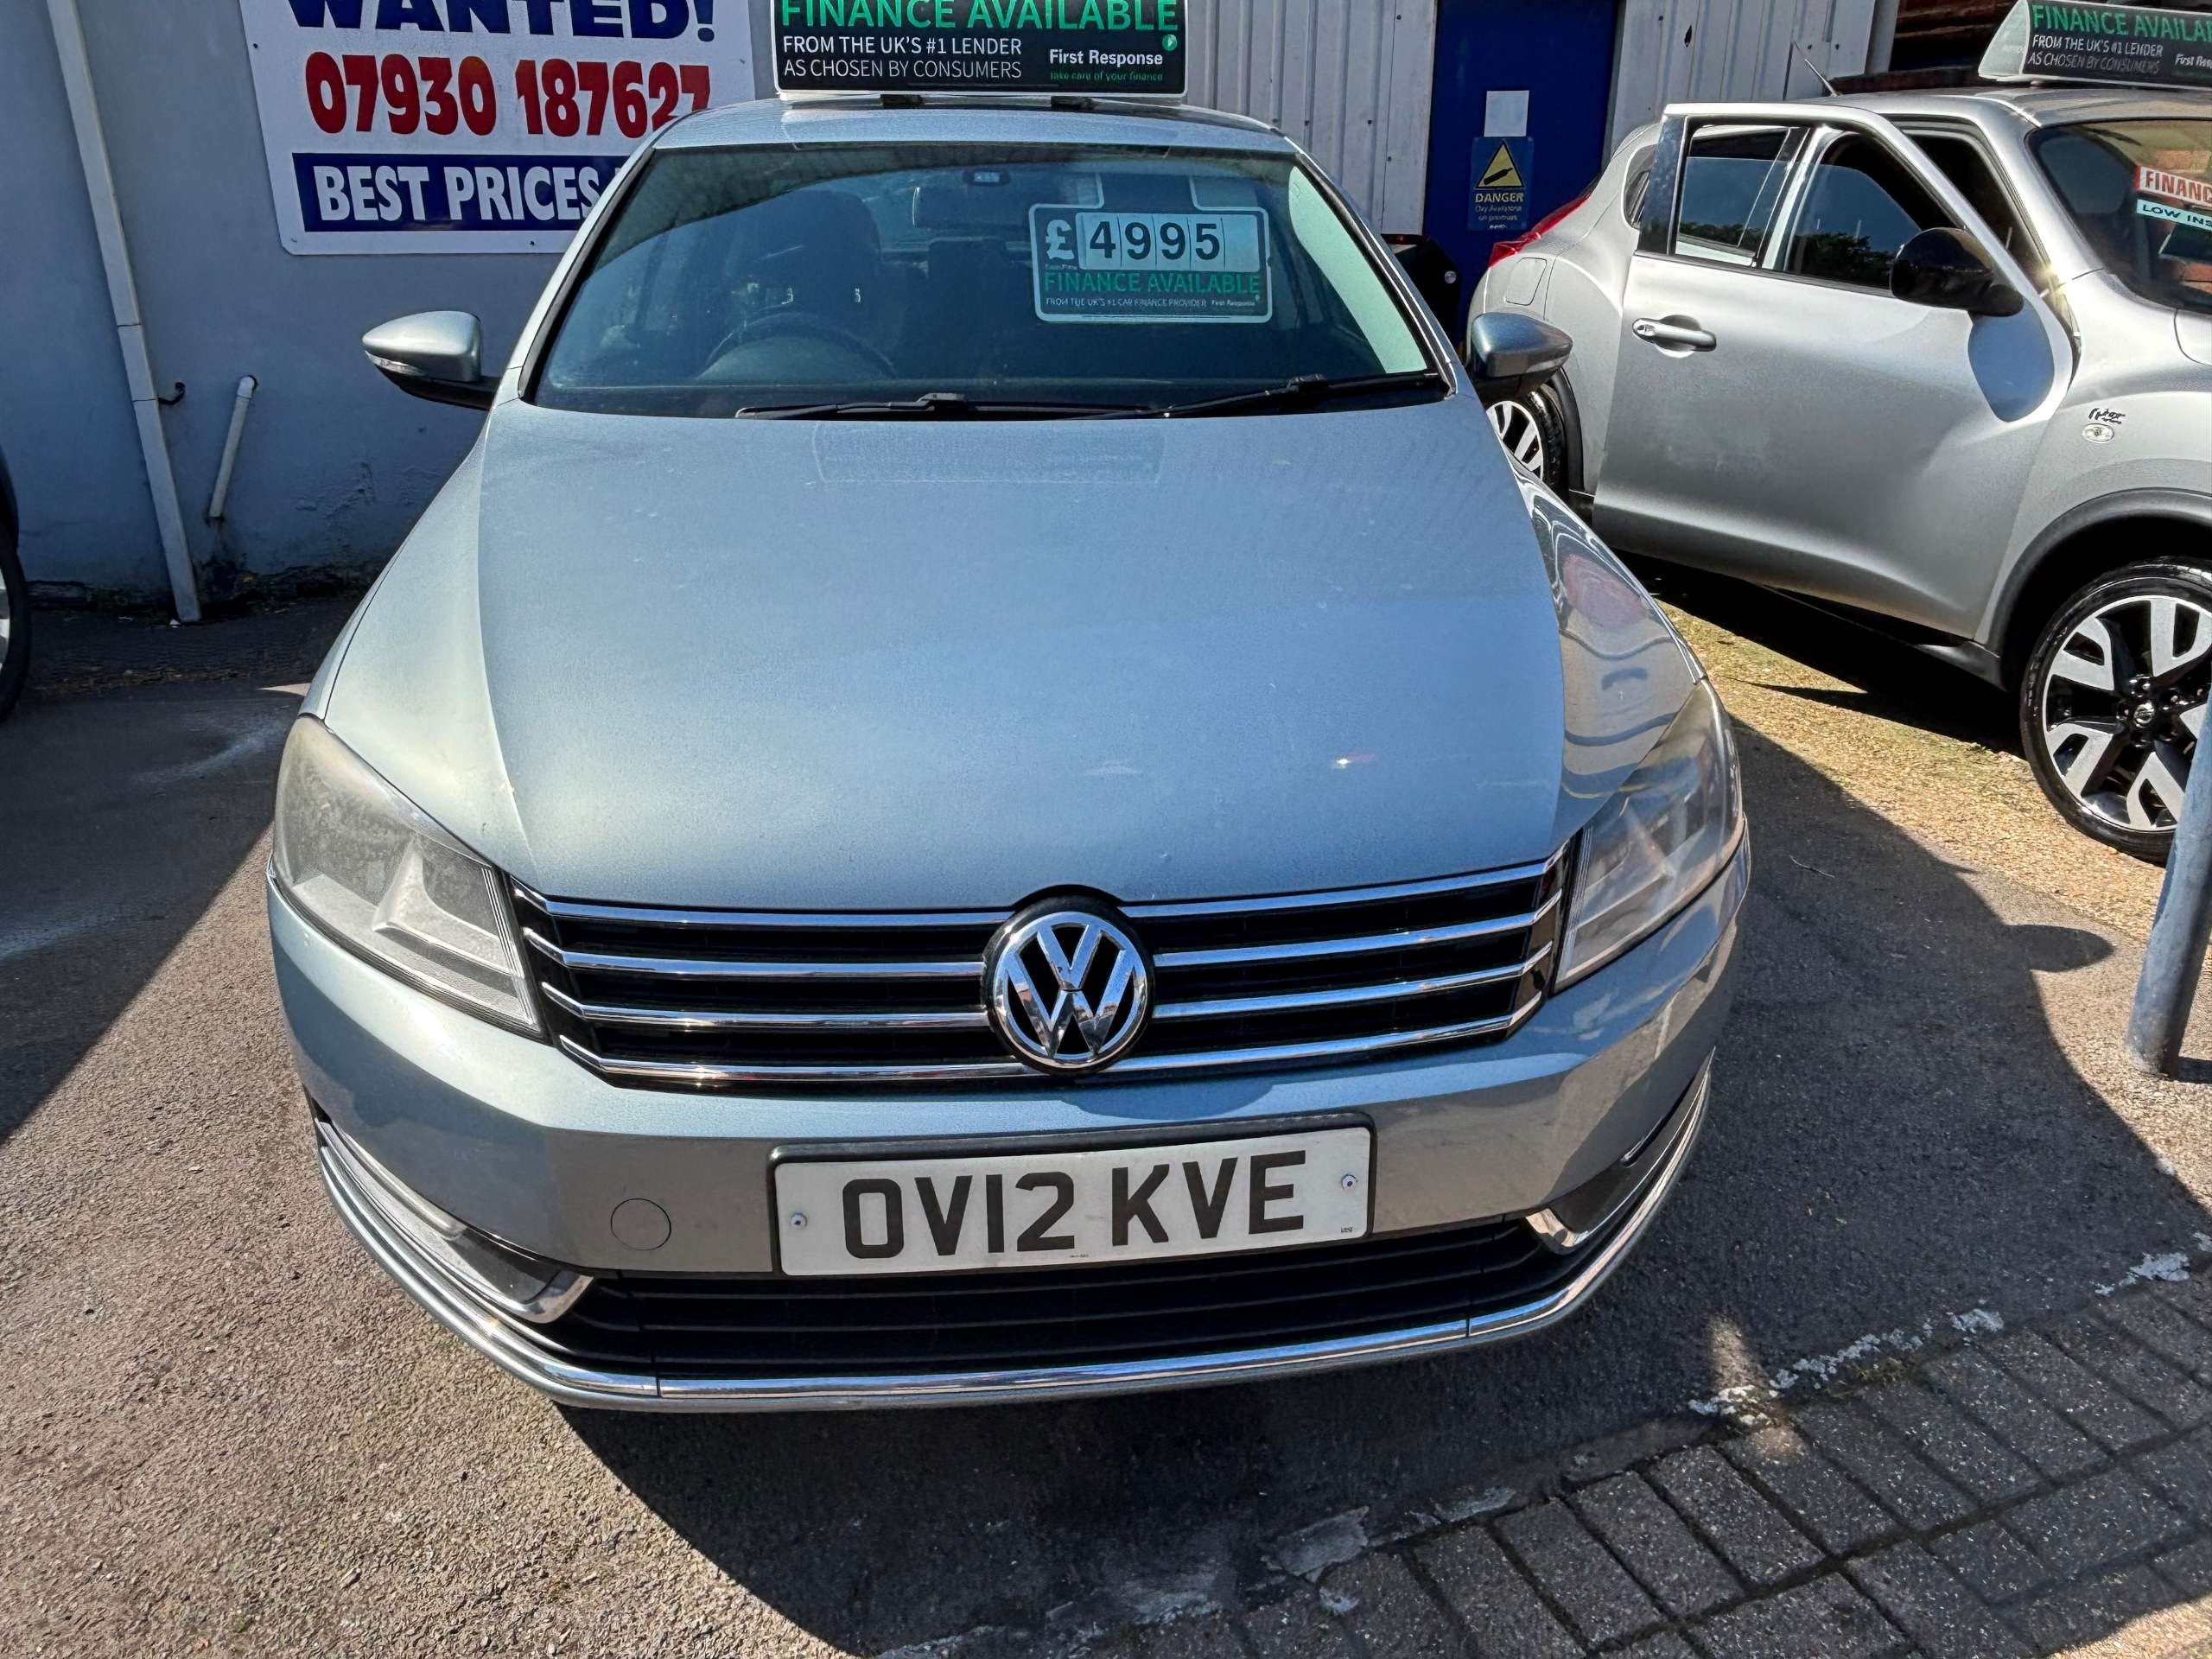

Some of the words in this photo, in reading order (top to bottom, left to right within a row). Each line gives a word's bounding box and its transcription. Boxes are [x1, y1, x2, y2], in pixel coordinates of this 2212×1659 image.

[288, 0, 715, 42] WANTED!
[782, 0, 956, 28] FINANCE
[967, 0, 1179, 31] AVAILABLE
[2032, 4, 2129, 35] FINANCE
[783, 35, 835, 54] FROM
[839, 36, 875, 54] THE
[880, 36, 922, 54] UK'S
[926, 37, 947, 54] #1
[952, 37, 1022, 55] LENDER
[2032, 35, 2063, 48] FROM
[2064, 37, 2084, 51] THE
[2125, 42, 2164, 57] LENDER
[1049, 48, 1084, 64] First
[1089, 49, 1163, 67] Response
[2027, 51, 2043, 66] AS
[2044, 53, 2086, 68] CHOSEN
[784, 59, 807, 77] AS
[810, 59, 883, 77] CHOSEN
[889, 60, 909, 77] BY
[913, 60, 1022, 79] CONSUMERS
[1094, 70, 1104, 79] of
[1105, 73, 1126, 82] your
[1128, 71, 1163, 81] finance
[305, 51, 497, 136] 07930
[515, 58, 711, 138] 187627
[313, 165, 430, 221] BEST
[443, 165, 601, 221] PRICES
[1475, 193, 1524, 203] DANGER
[2143, 204, 2182, 219] LOW
[1044, 271, 1141, 292] FINANCE
[1147, 273, 1261, 294] AVAILABLE
[842, 1171, 1076, 1260] OV12
[1111, 1149, 1306, 1247] KVE
